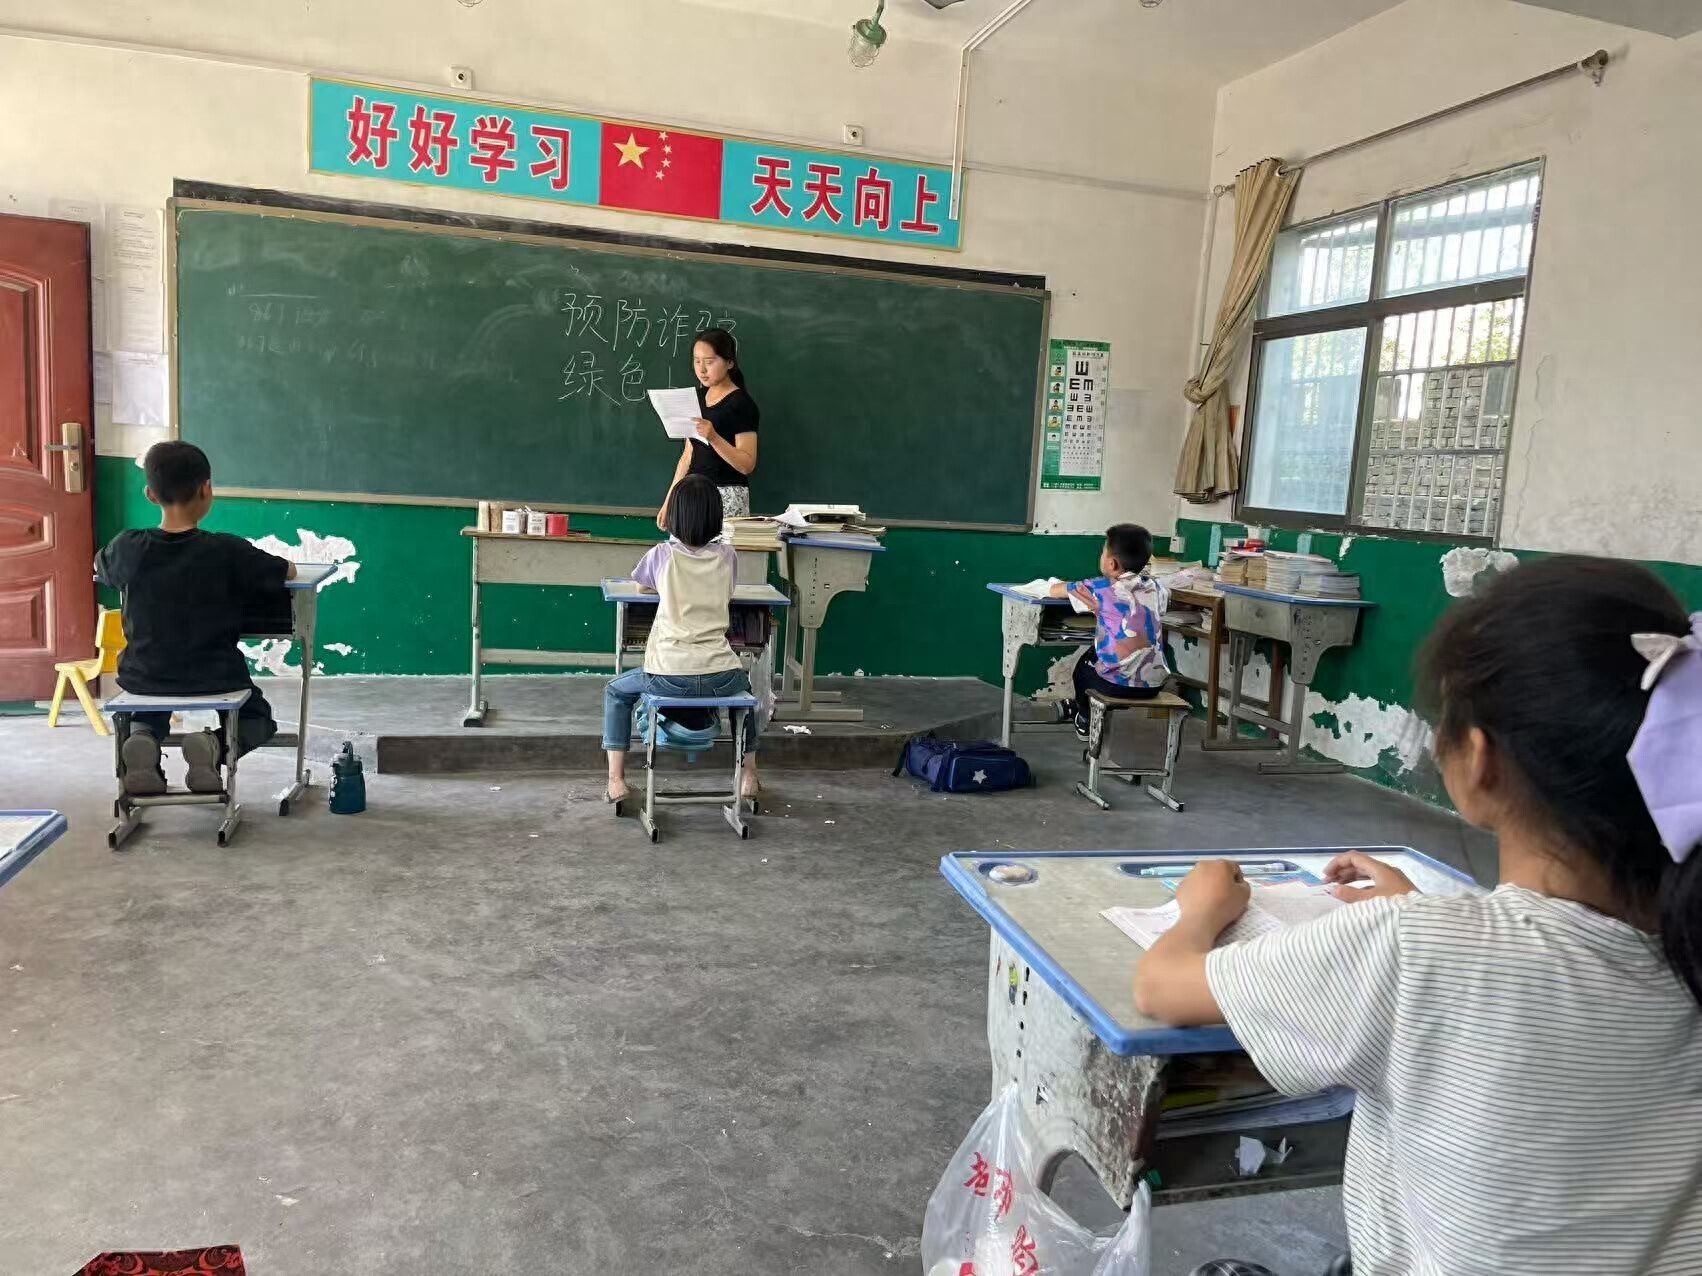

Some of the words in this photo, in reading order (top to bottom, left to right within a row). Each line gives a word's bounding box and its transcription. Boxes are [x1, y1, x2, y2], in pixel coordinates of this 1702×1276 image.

[347, 95, 571, 191] 好好学习
[750, 155, 940, 234] 天天向上
